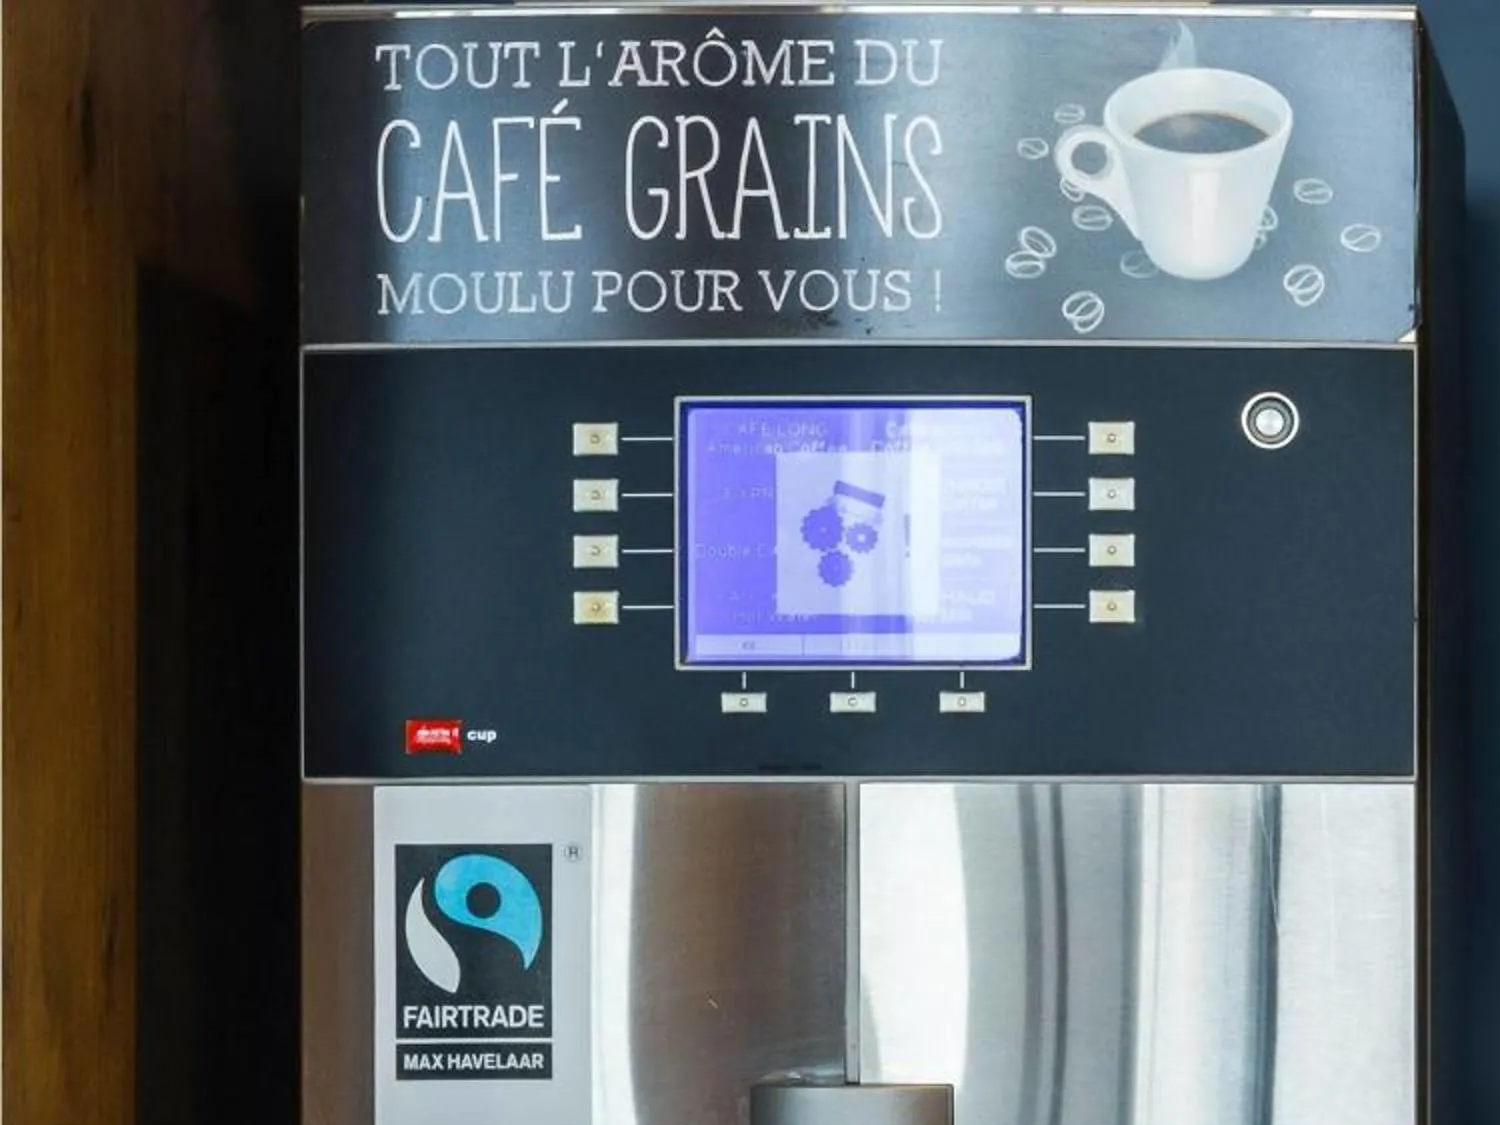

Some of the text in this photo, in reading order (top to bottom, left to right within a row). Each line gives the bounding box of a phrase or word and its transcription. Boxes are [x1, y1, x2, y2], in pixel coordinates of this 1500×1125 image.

[375, 26, 944, 91] TOUT L'ARÔME DU
[377, 98, 943, 243] CAFÉ GRAINS
[376, 271, 576, 315] MOULU
[591, 269, 743, 313] POUR
[757, 269, 912, 312] VOUS
[467, 730, 497, 743] cup
[403, 1004, 545, 1029] FAIRTRADE
[403, 1053, 544, 1070] MAX HAVELAAR
